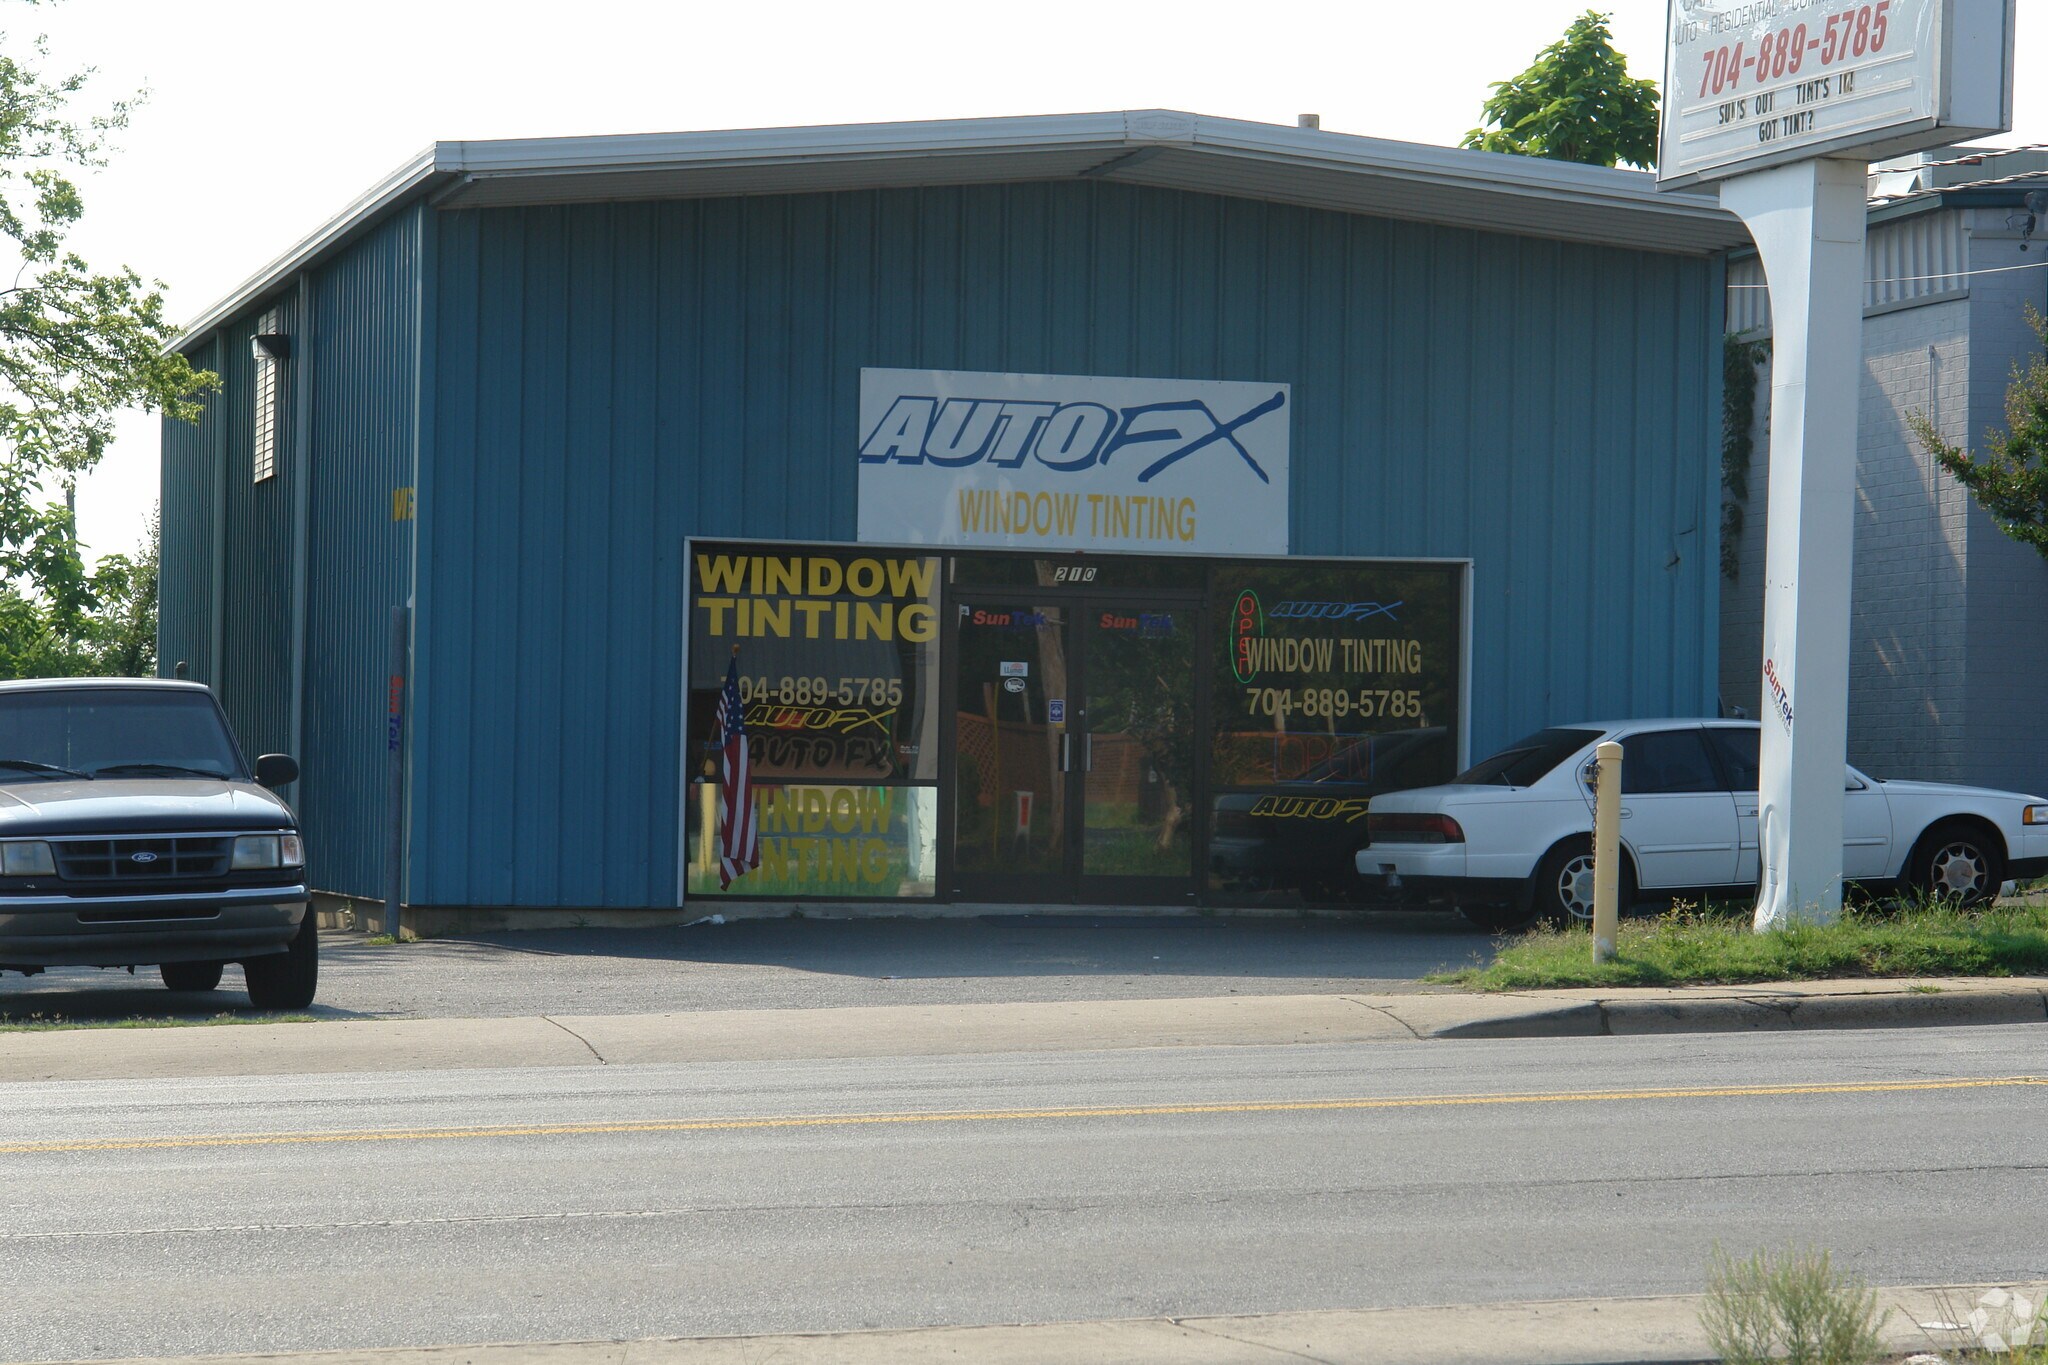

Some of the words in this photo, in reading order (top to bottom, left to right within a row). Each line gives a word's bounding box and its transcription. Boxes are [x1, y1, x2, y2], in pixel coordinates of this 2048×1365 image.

[1711, 0, 1777, 36] RESIDENTIAL
[1700, 1, 1890, 98] 704-889-5785
[1719, 99, 1745, 124] SUN'S
[1755, 92, 1774, 115] OUT
[1796, 78, 1830, 104] TINT'S
[1759, 119, 1777, 142] GOT
[1783, 110, 1813, 136] TINT?
[959, 489, 1079, 537] WINDOW
[1087, 493, 1196, 542] TINTING
[697, 554, 938, 598] WINDOW
[1054, 566, 1098, 582] 210
[698, 597, 938, 643] TINTING
[1245, 637, 1335, 674] WINDOW
[1340, 638, 1422, 675] TINTING
[721, 676, 903, 706] 04-889-5785
[1246, 688, 1422, 718] 704-889-5785
[1764, 658, 1794, 727] SunTek
[752, 787, 894, 833] INDOW
[750, 837, 890, 883] NTING
